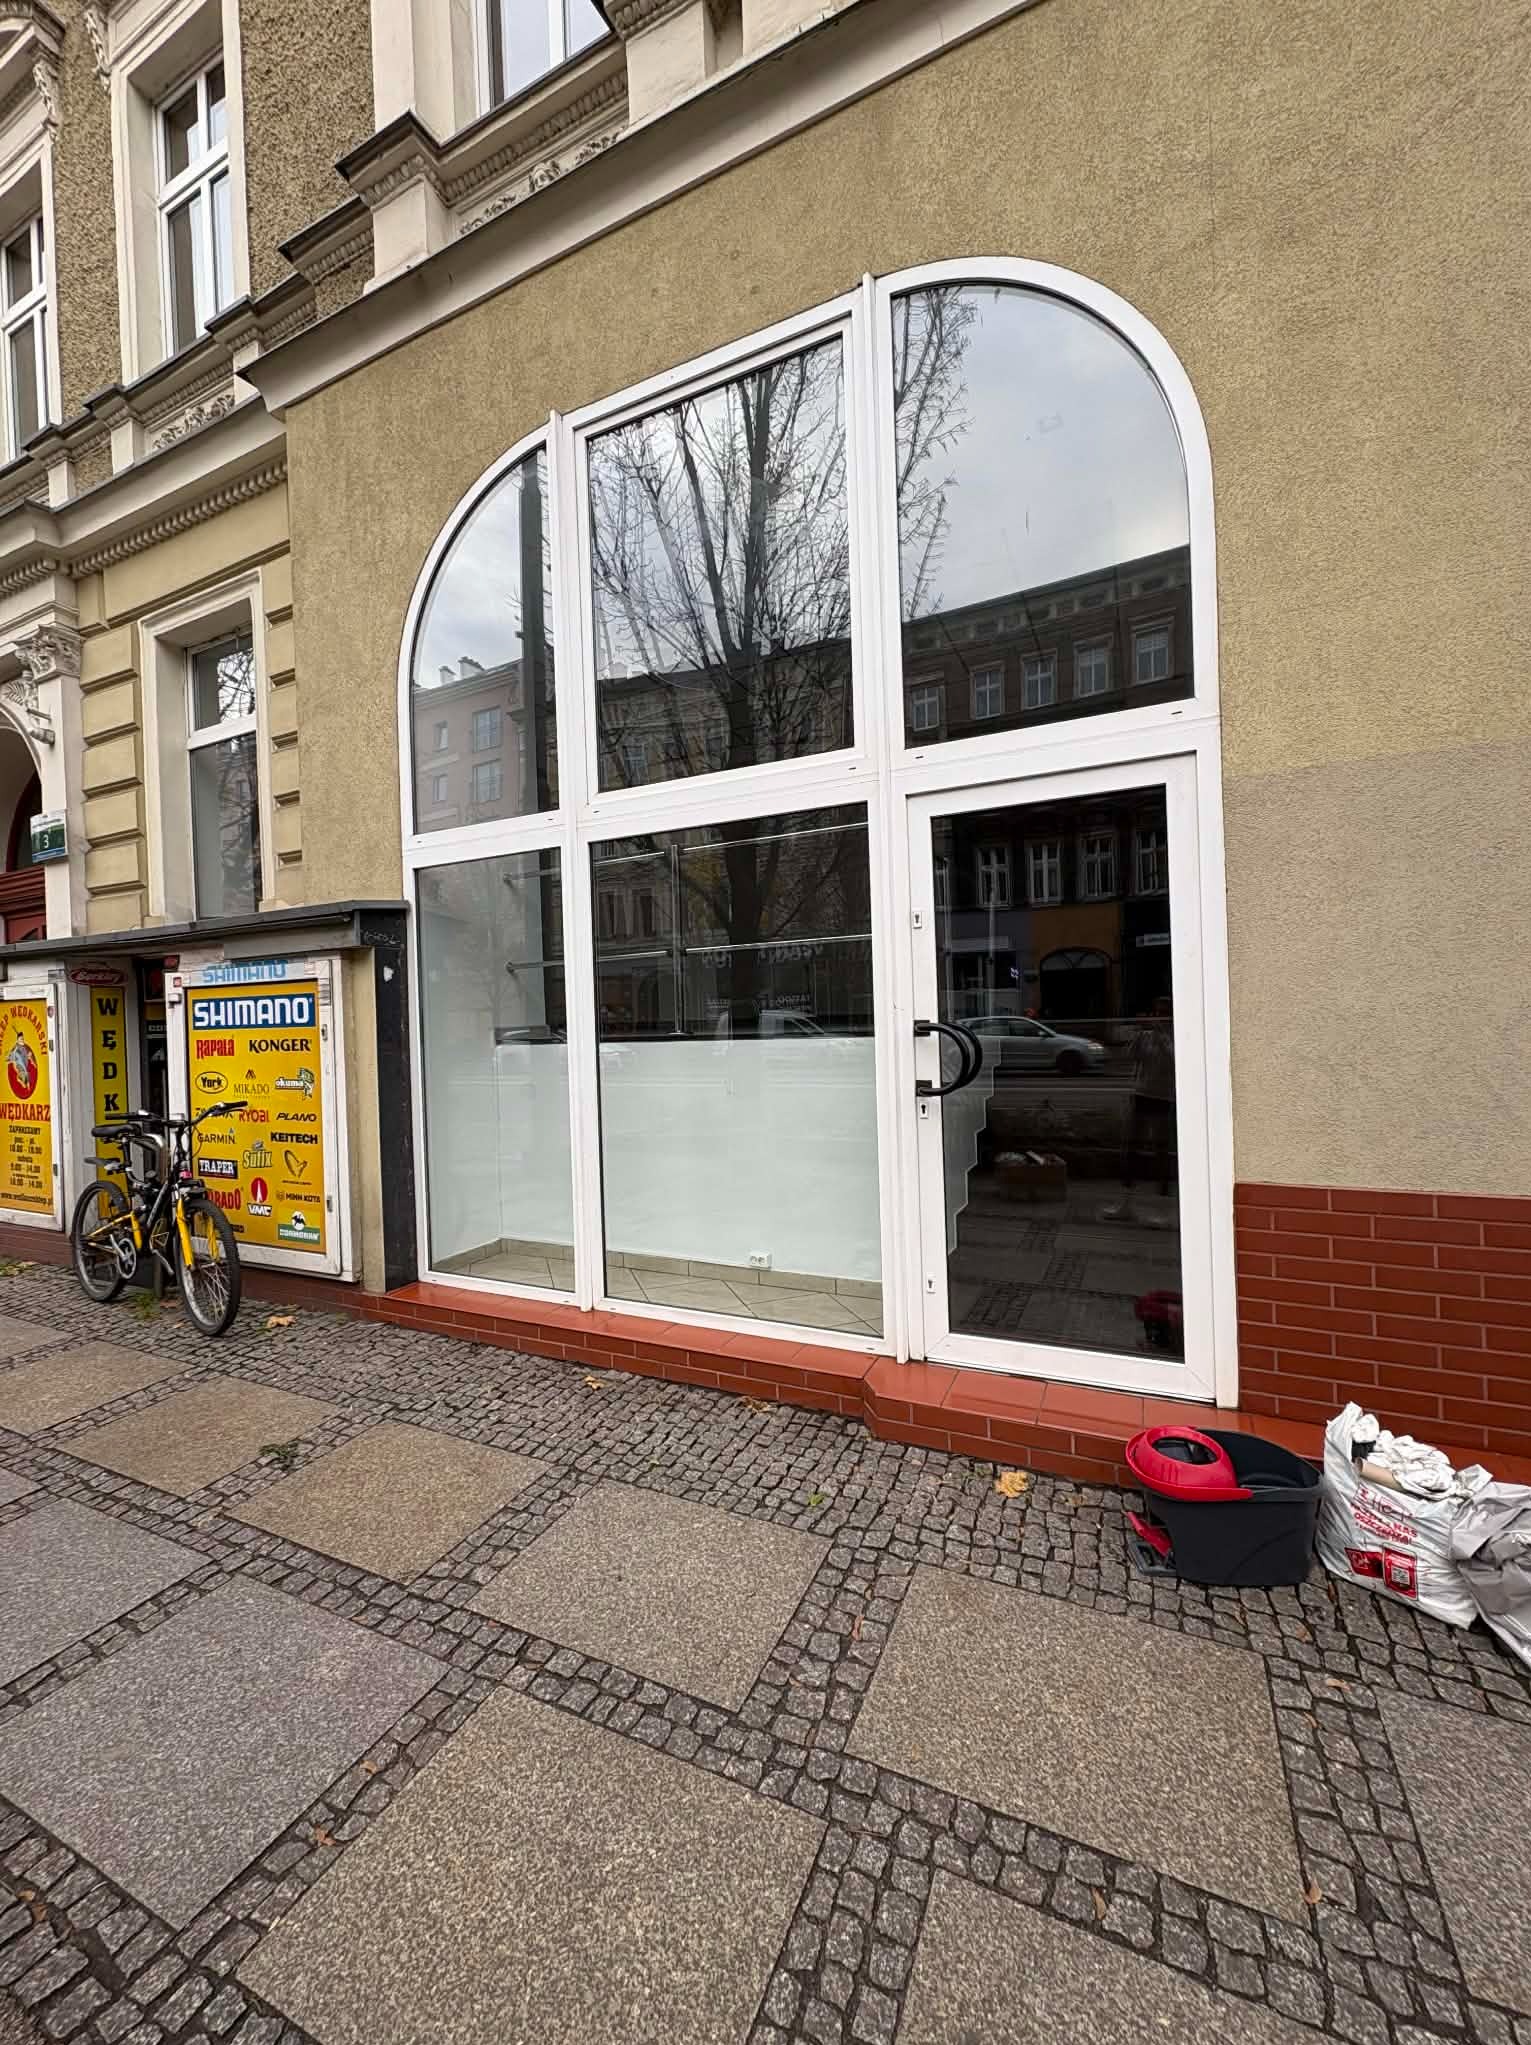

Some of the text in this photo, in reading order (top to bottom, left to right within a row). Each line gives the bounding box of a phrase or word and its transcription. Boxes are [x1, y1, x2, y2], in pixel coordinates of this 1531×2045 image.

[42, 834, 49, 848] 3
[202, 960, 288, 983] SHIMANO
[194, 998, 309, 1027] SHIMANO
[249, 1038, 310, 1053] KONGER
[201, 1076, 222, 1089] York
[234, 1083, 270, 1095] MIKADO
[275, 1077, 304, 1089] okuma
[239, 1109, 269, 1122] RYOBI
[276, 1112, 317, 1122] PLANO
[198, 1133, 236, 1144] GARMIN
[270, 1132, 318, 1145] KEITECH
[243, 1150, 272, 1168] Sufix
[199, 1160, 234, 1175] TRAPER
[248, 1204, 272, 1217] VMC
